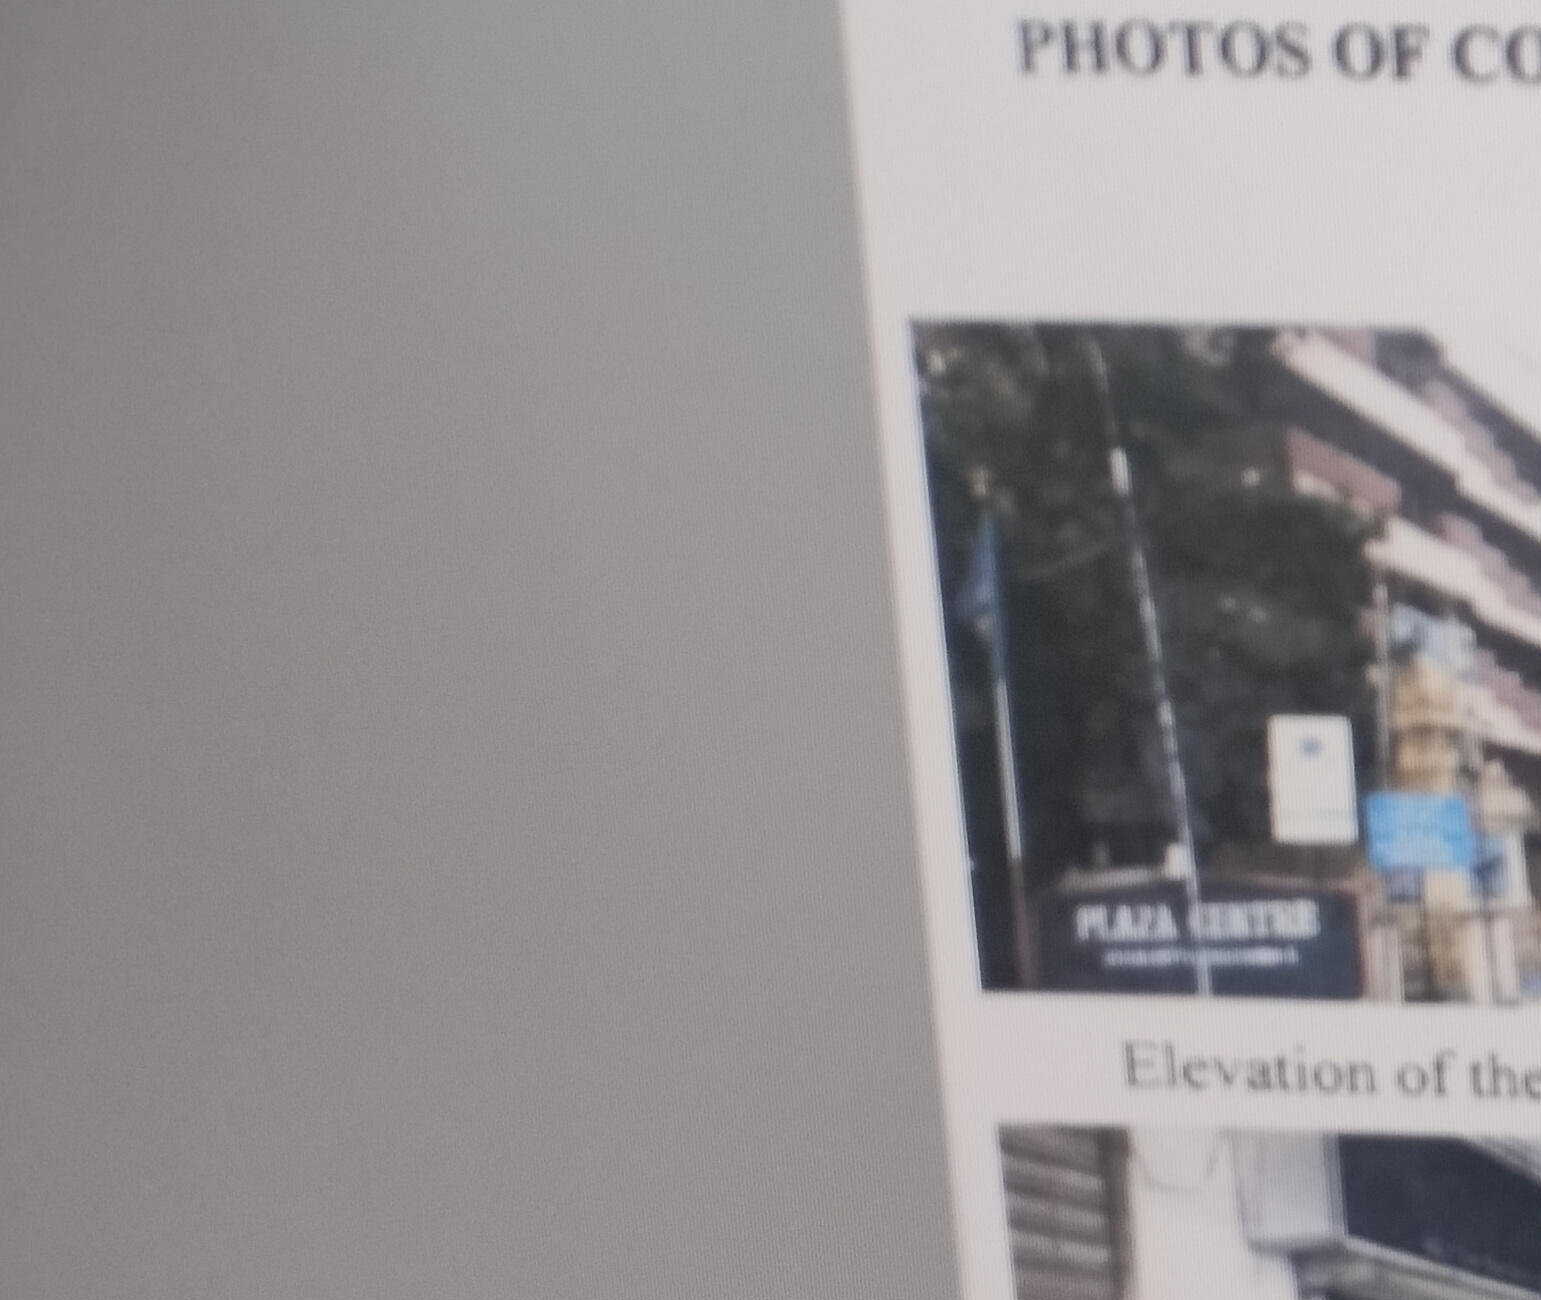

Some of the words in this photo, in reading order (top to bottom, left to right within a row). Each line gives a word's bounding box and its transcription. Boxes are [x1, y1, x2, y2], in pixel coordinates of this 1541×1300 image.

[1019, 21, 1311, 76] PHOTOS
[1332, 25, 1427, 80] OF
[1077, 903, 1180, 942] PLAZA
[1123, 1041, 1377, 1095] Elevation
[1395, 1051, 1453, 1098] of
